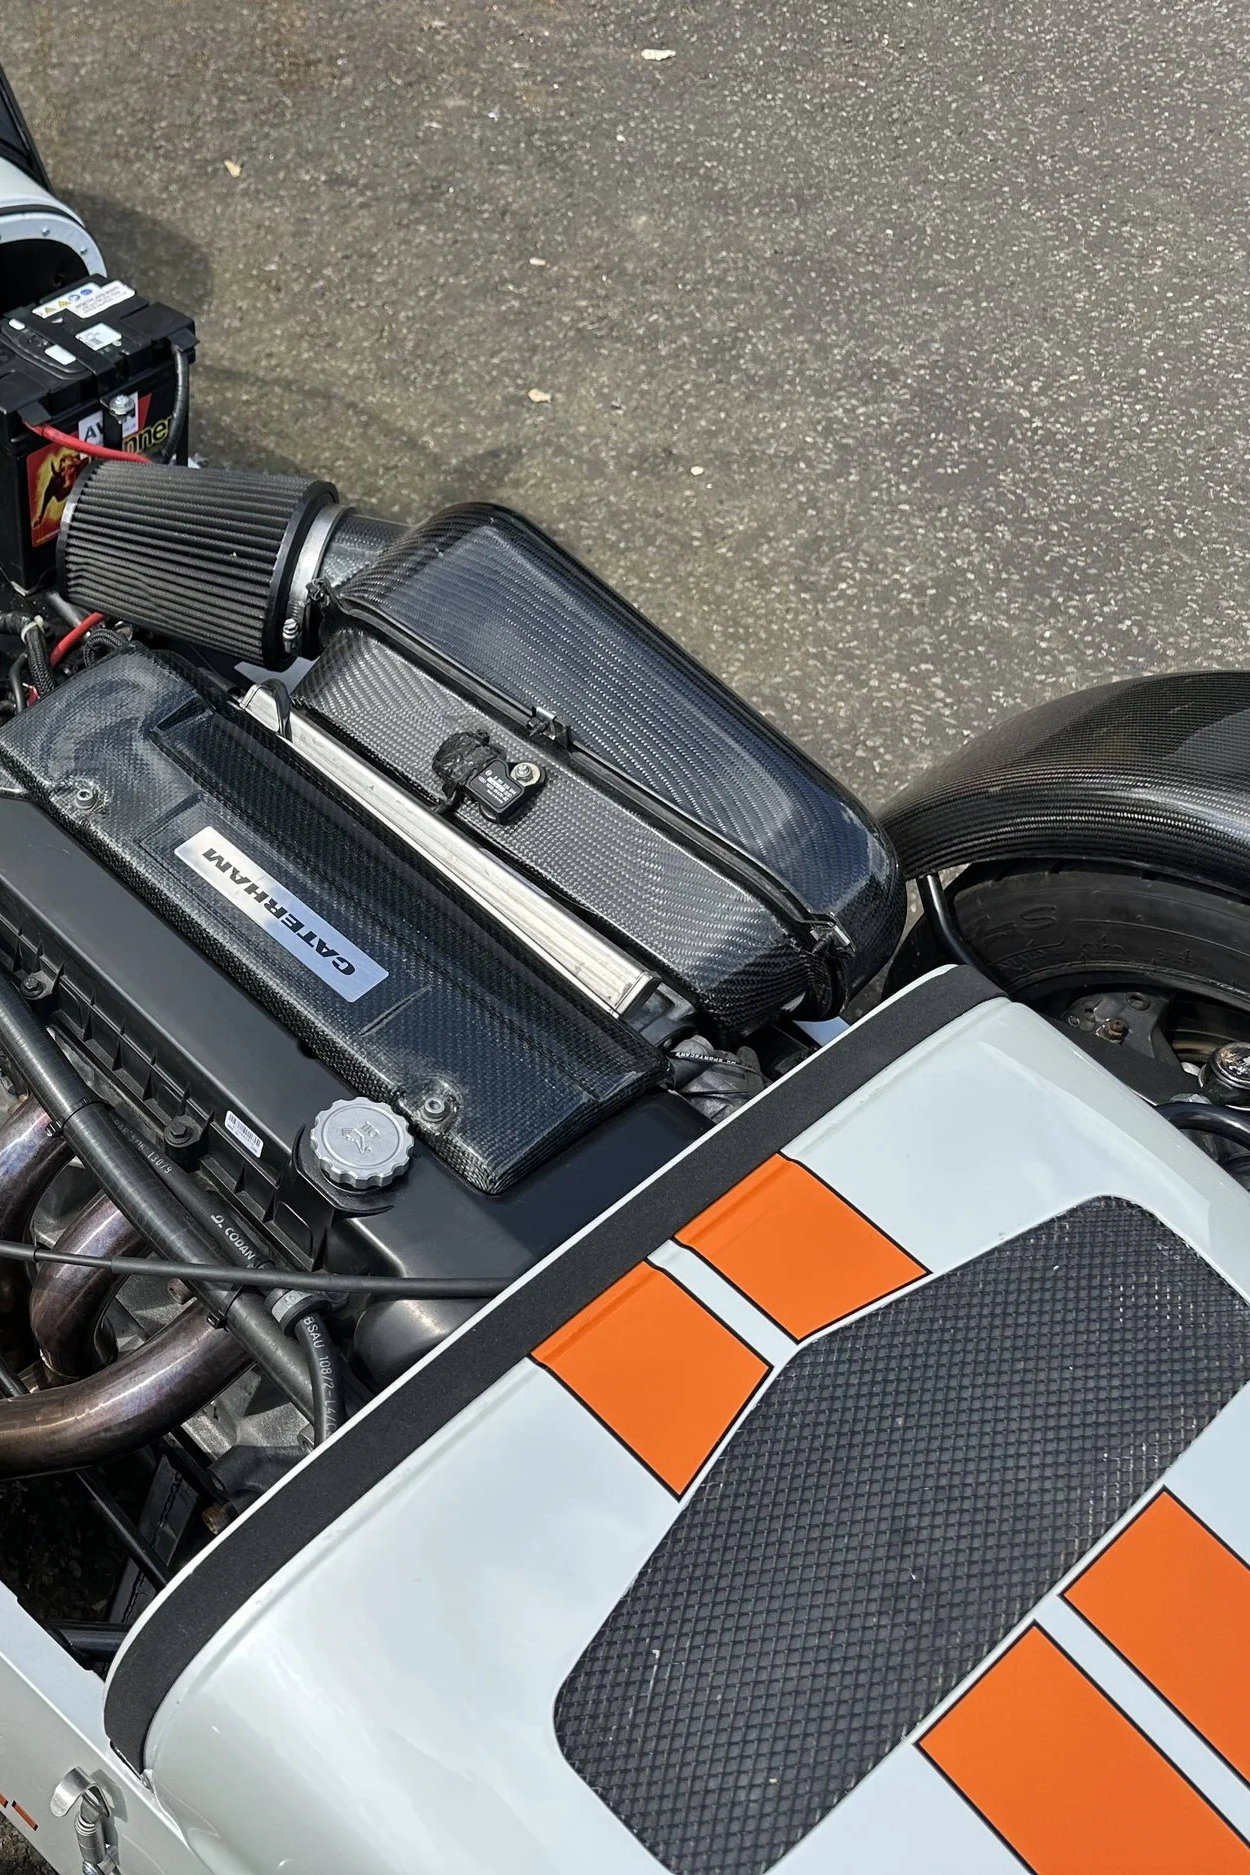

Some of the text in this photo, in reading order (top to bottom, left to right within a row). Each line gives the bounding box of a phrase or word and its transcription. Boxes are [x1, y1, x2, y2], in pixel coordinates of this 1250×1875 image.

[200, 847, 357, 978] CATERHAM
[225, 1226, 256, 1264] CODAN
[303, 1316, 325, 1349] BSAU
